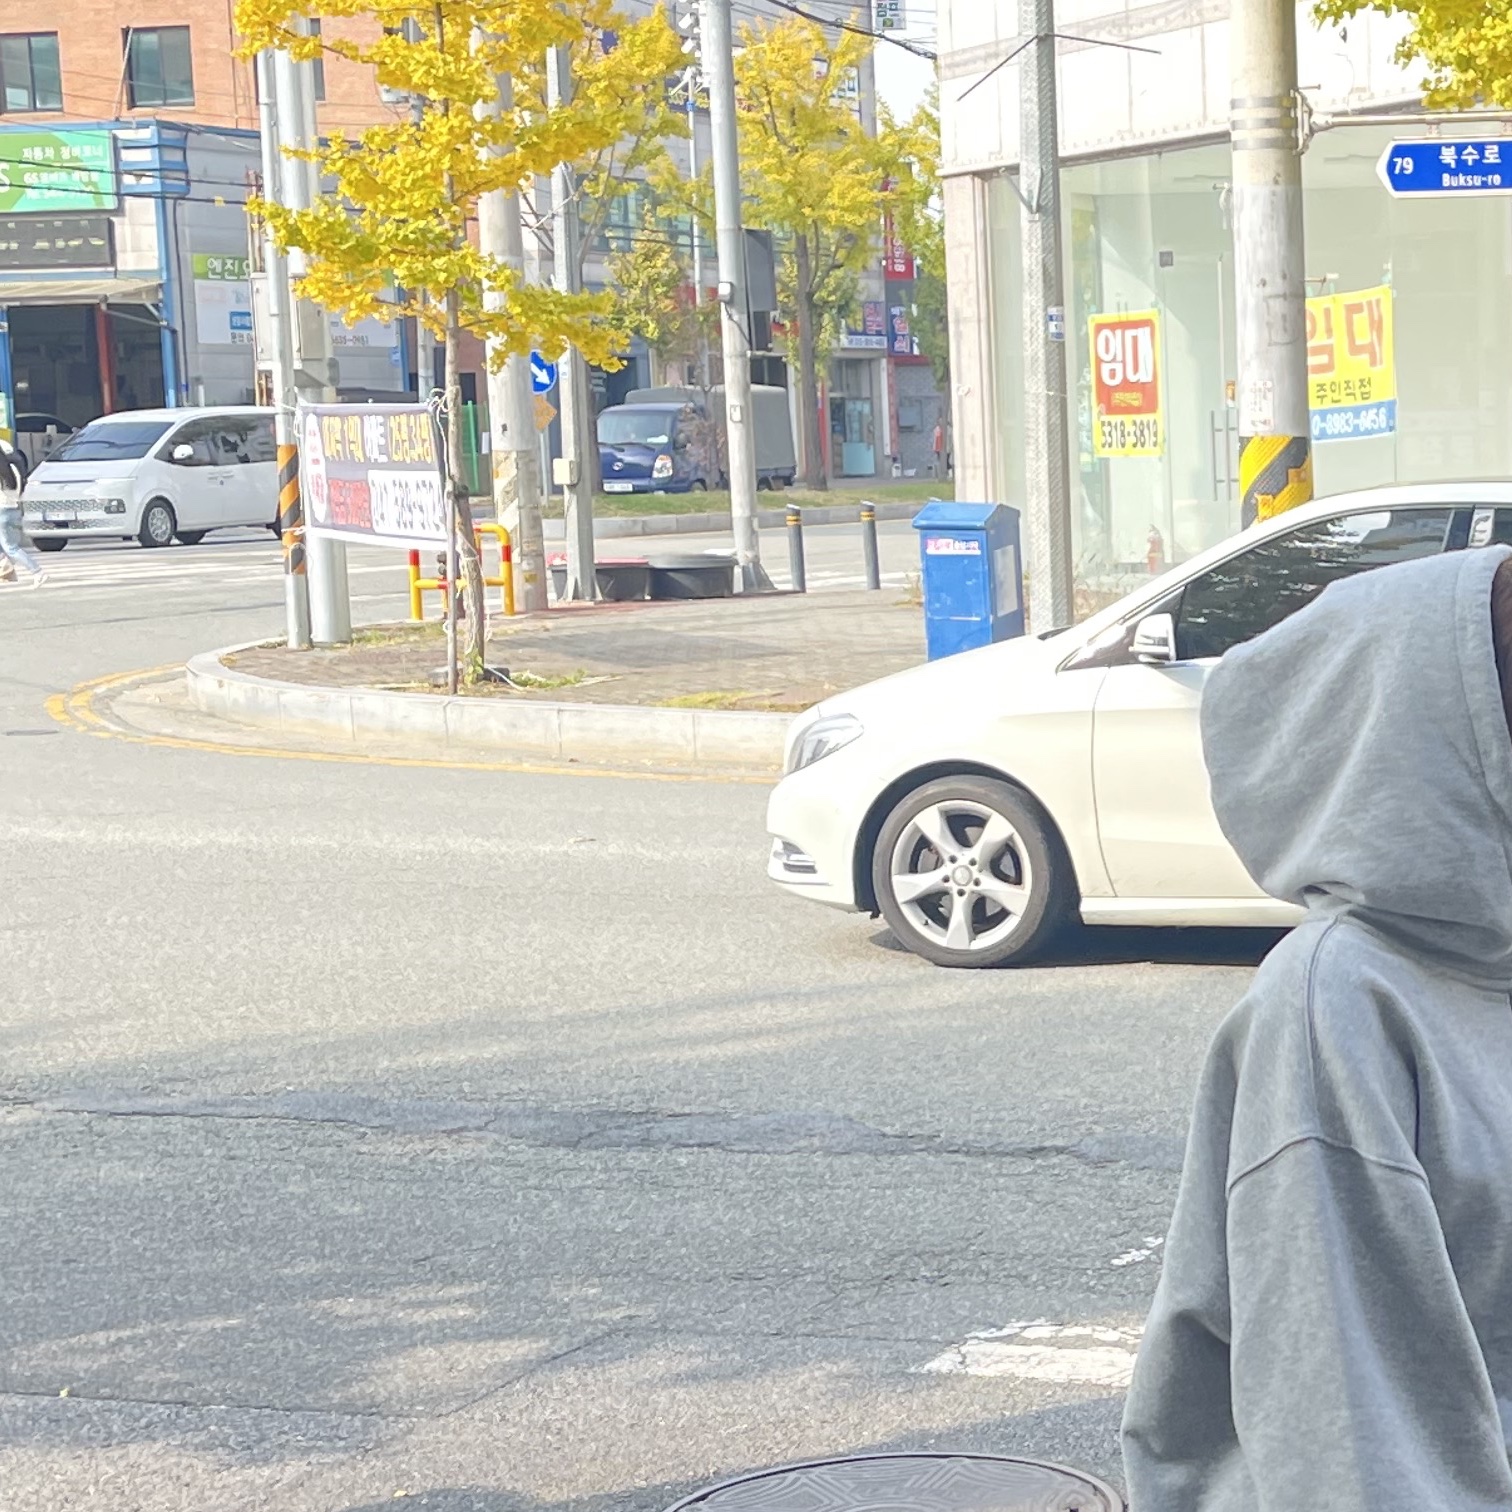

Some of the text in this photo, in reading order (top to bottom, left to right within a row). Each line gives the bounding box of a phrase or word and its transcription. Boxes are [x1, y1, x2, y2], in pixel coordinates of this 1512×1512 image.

[1393, 157, 1414, 175] 79
[1439, 144, 1502, 169] 북수로
[1441, 173, 1502, 187] Buksu-ro
[1306, 298, 1383, 375] 임대
[1097, 326, 1154, 387] 임대
[1317, 377, 1372, 405] 주인직접
